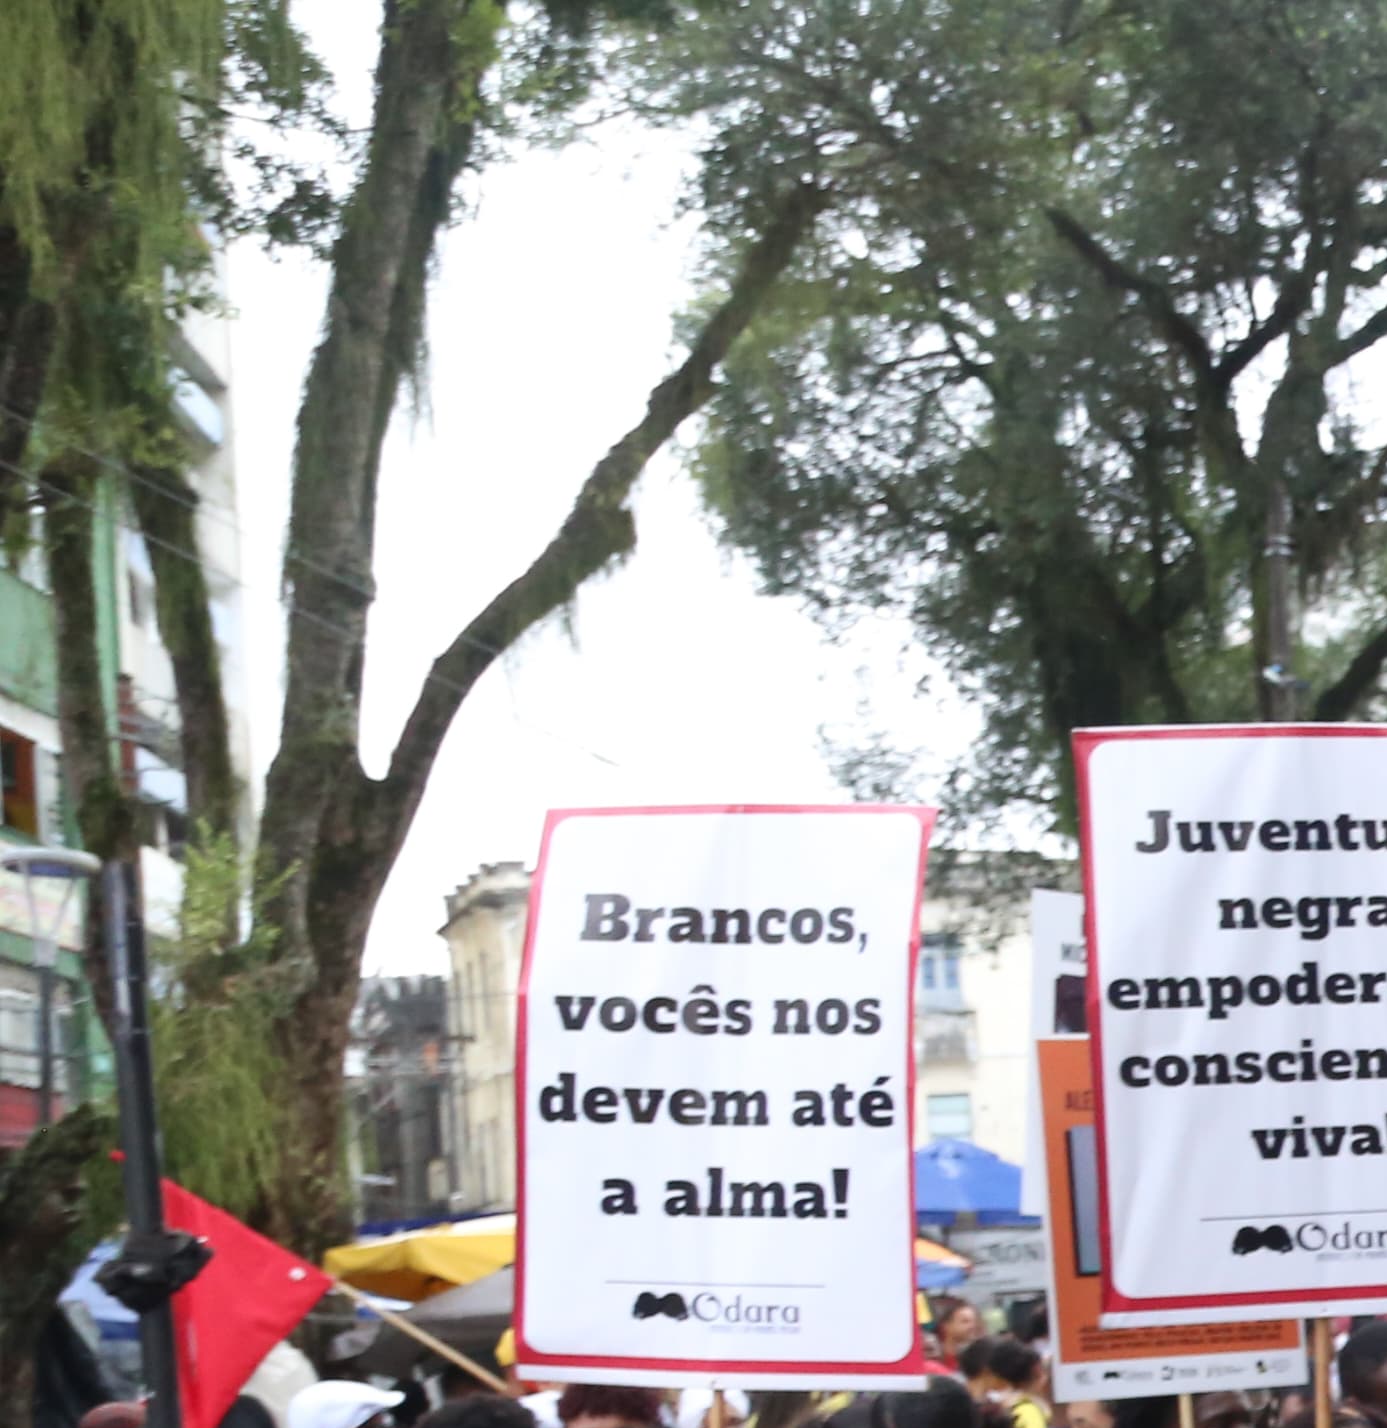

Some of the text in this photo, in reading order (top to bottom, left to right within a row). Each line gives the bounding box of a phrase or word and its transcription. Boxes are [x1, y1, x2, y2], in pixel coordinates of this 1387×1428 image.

[582, 894, 866, 951] Brancos,
[555, 985, 881, 1035] vocês nos
[539, 1073, 894, 1127] devem até
[601, 1168, 849, 1219] a alma!
[691, 1292, 802, 1324] Odara
